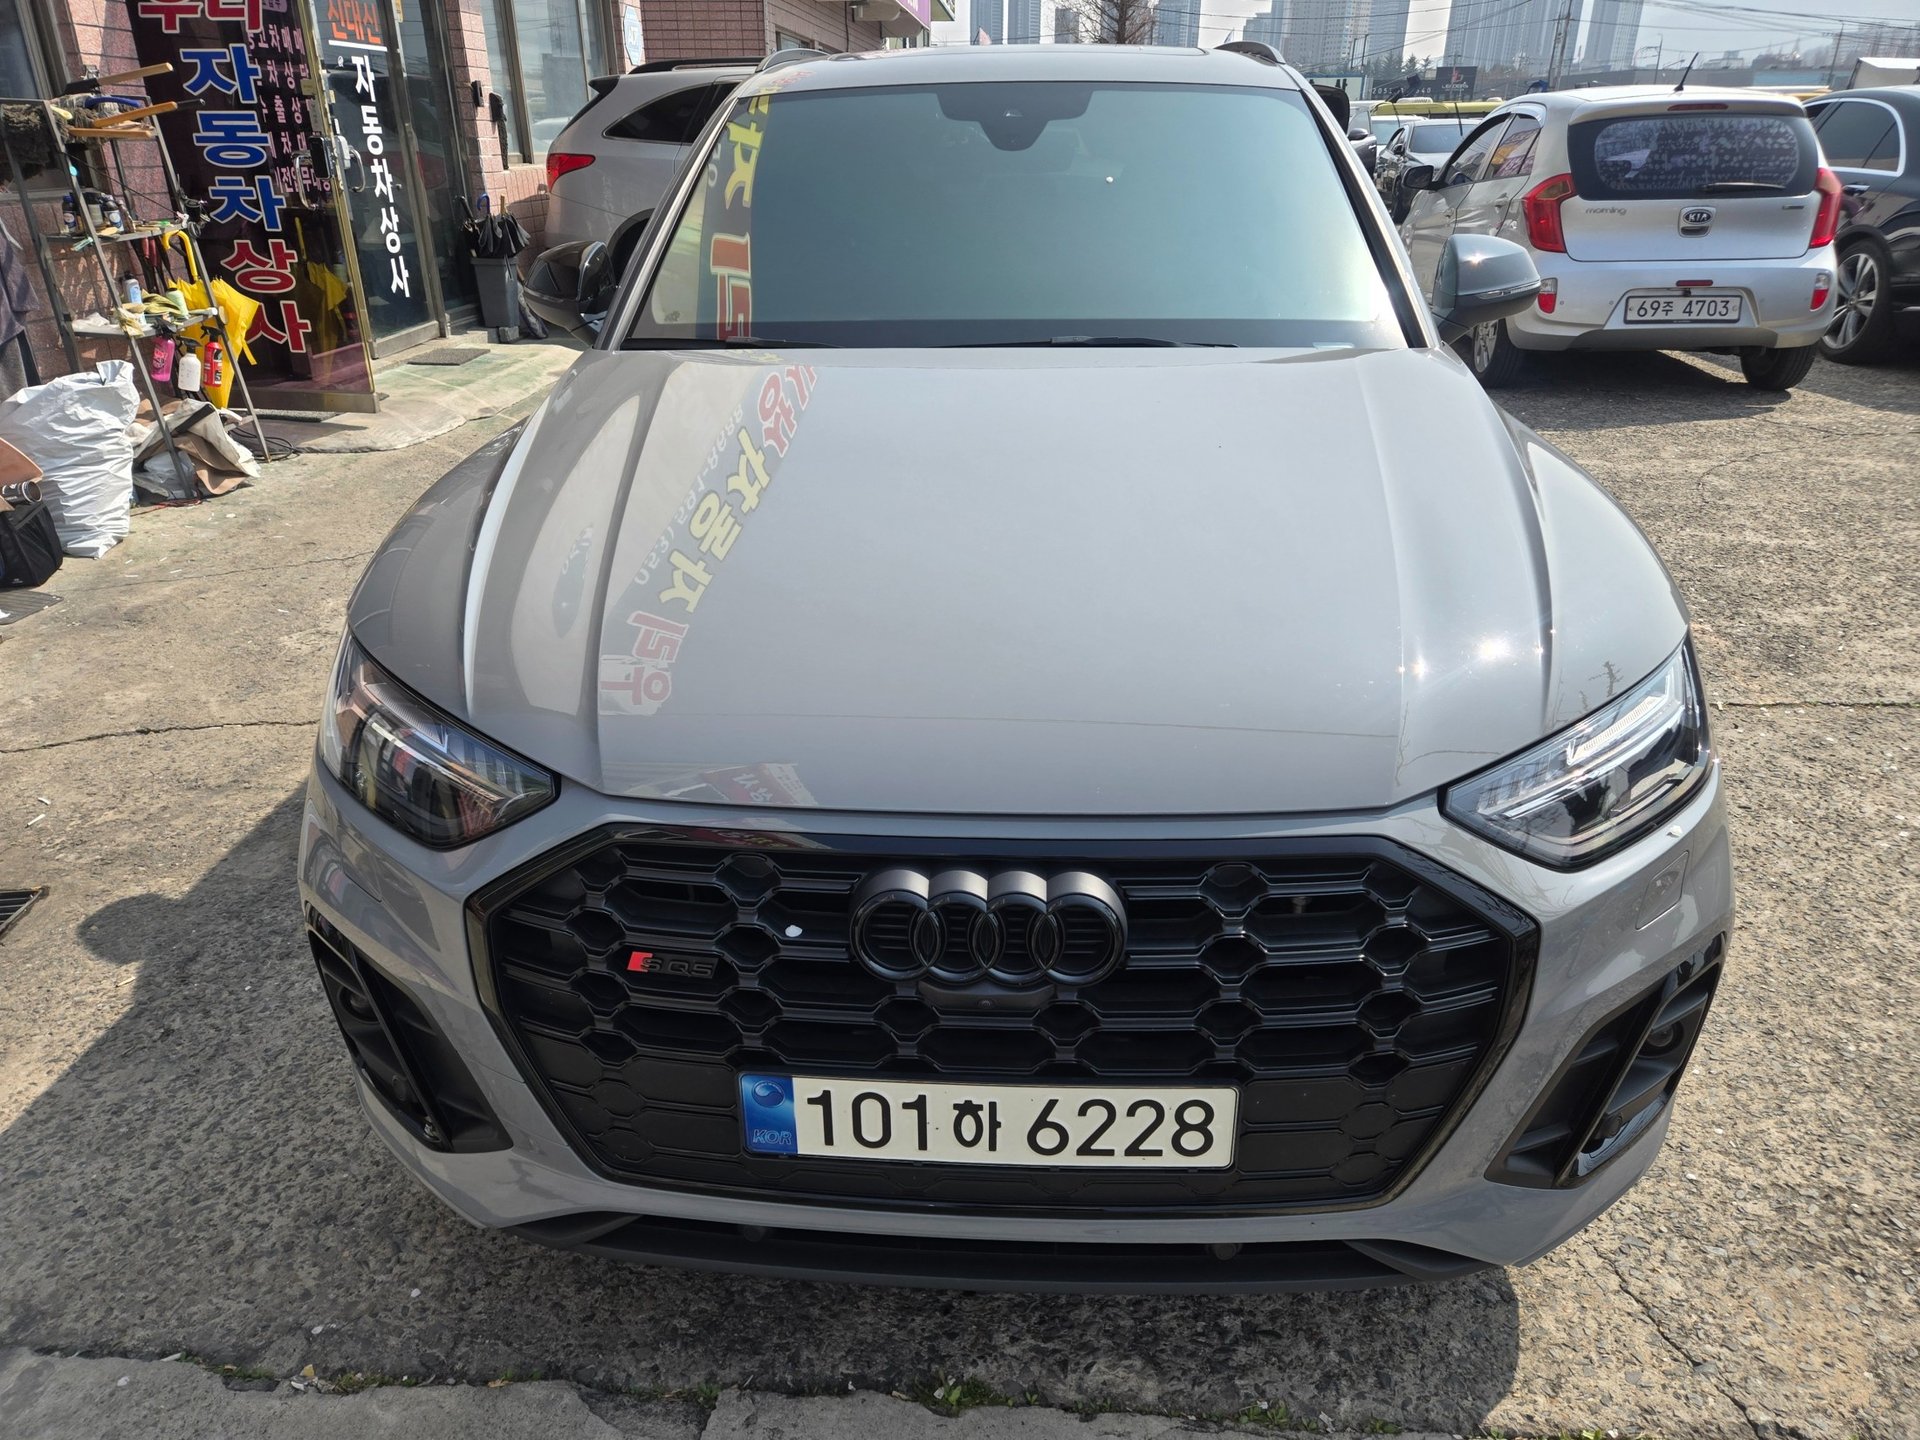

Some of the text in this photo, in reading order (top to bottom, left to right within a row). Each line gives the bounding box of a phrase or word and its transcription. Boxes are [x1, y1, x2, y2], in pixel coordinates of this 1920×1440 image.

[351, 54, 411, 298] 자동차상사
[1585, 207, 1627, 216] morning
[1688, 212, 1708, 222] KIA
[1636, 299, 1730, 318] 69주 4703
[636, 954, 714, 978] SQ5
[806, 1089, 1216, 1158] 101하 6228
[752, 1128, 792, 1145] KOR
